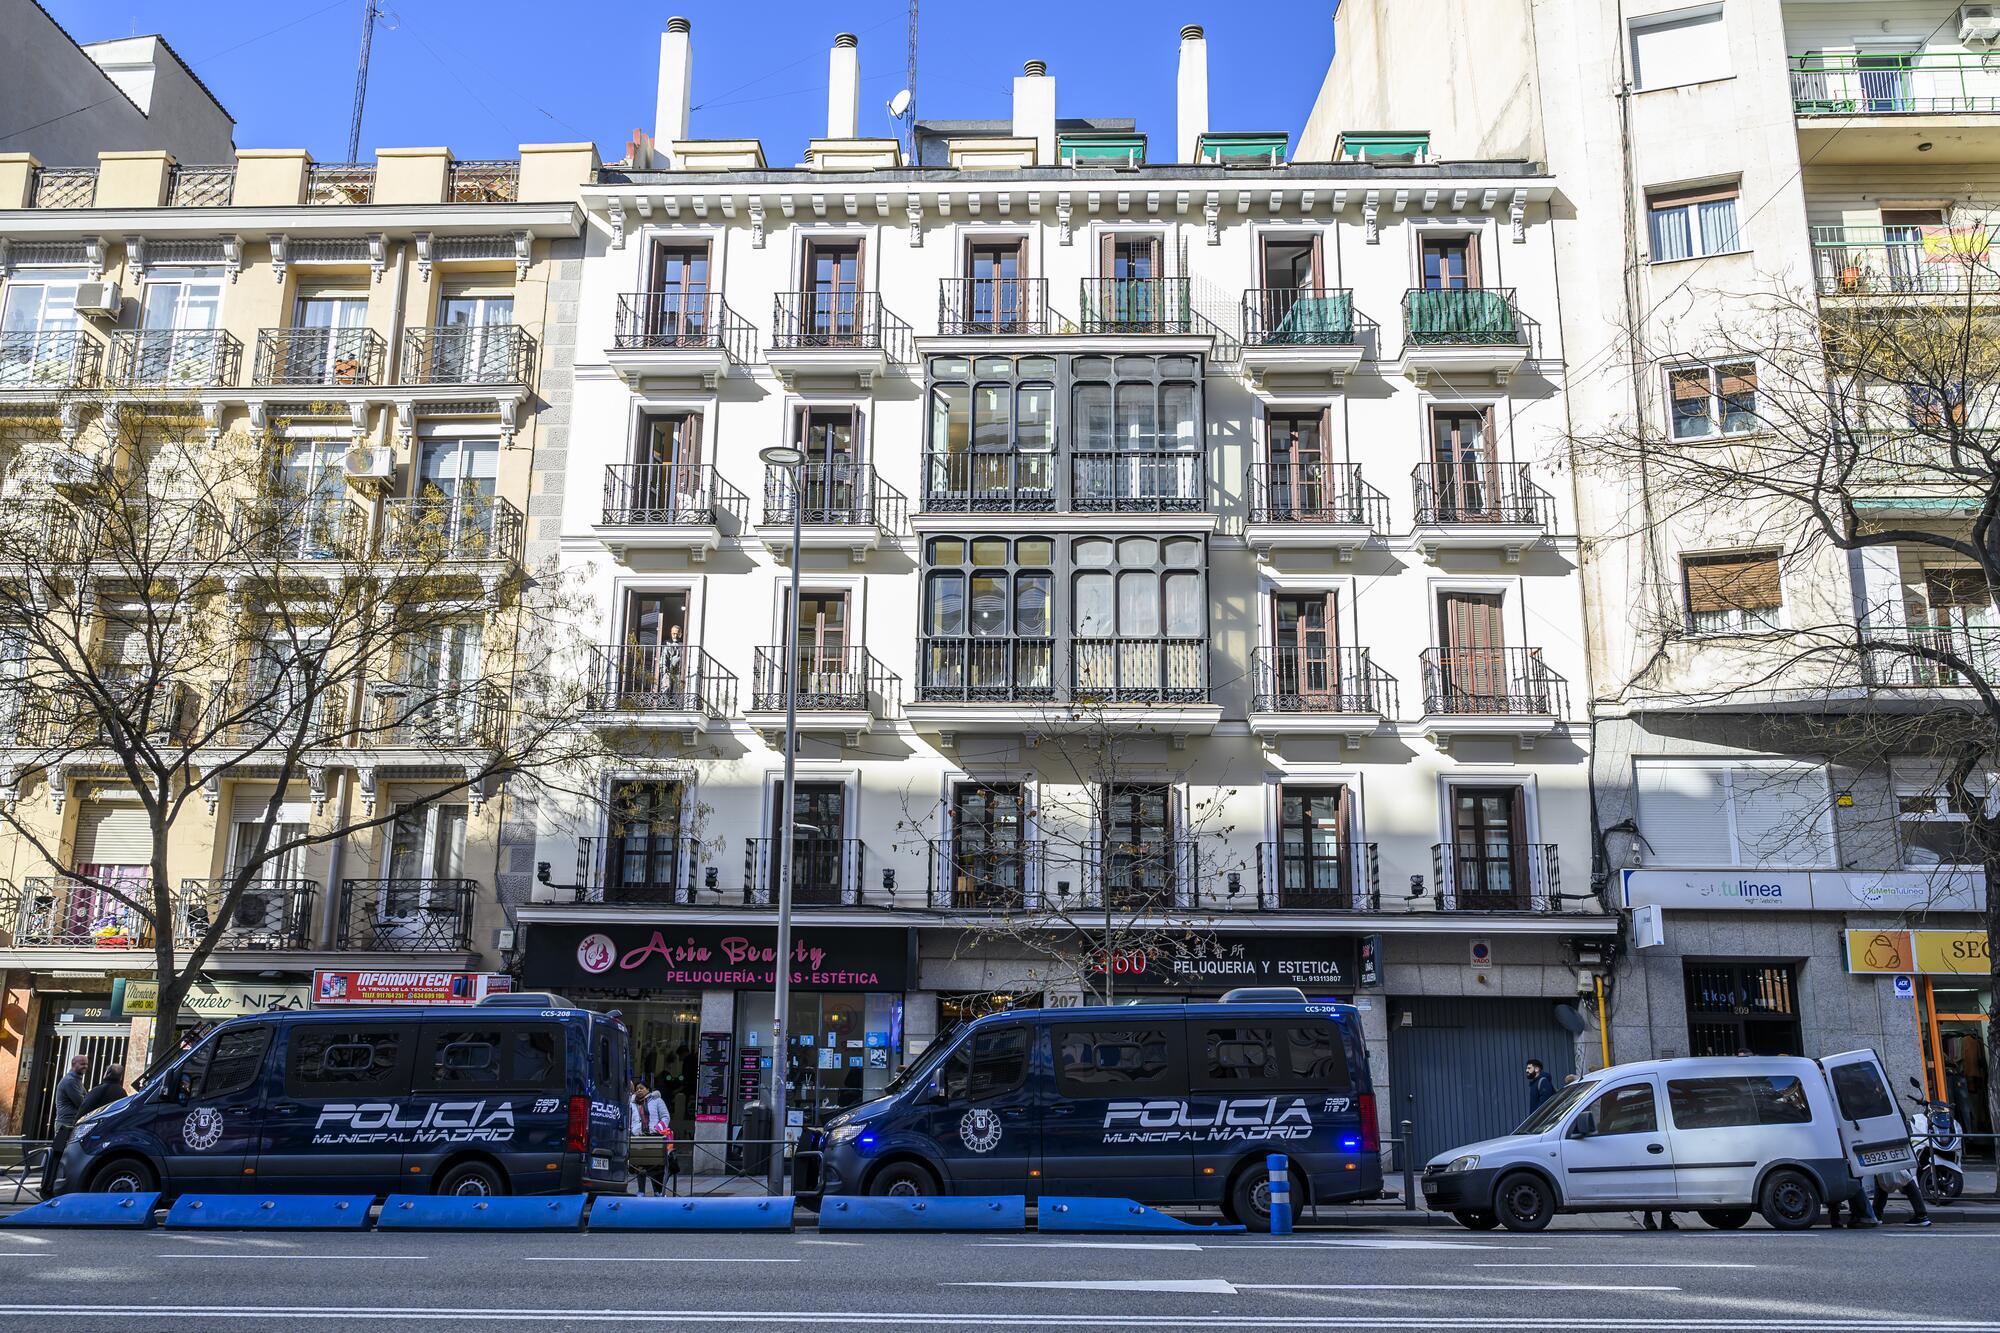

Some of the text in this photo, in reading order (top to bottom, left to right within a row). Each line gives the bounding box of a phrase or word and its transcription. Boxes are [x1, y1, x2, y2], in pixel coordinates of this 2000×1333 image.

[620, 931, 826, 970] Asia Beaty
[1174, 961, 1339, 974] PELUQUERIA Y ESTETICA
[357, 973, 452, 986] INFOMOVITECH
[667, 969, 755, 983] PELUQUERÍA
[812, 970, 878, 984] ESTÉTICA
[243, 994, 303, 1008] NIZA
[1050, 995, 1078, 1007] 207
[84, 1008, 102, 1017] 205
[1734, 1006, 1749, 1014] 209
[312, 1128, 515, 1144] MUNICIPAL MADRID
[1102, 1125, 1313, 1143] MUNICIPAL MADRID
[1864, 1151, 1888, 1163] 9928
